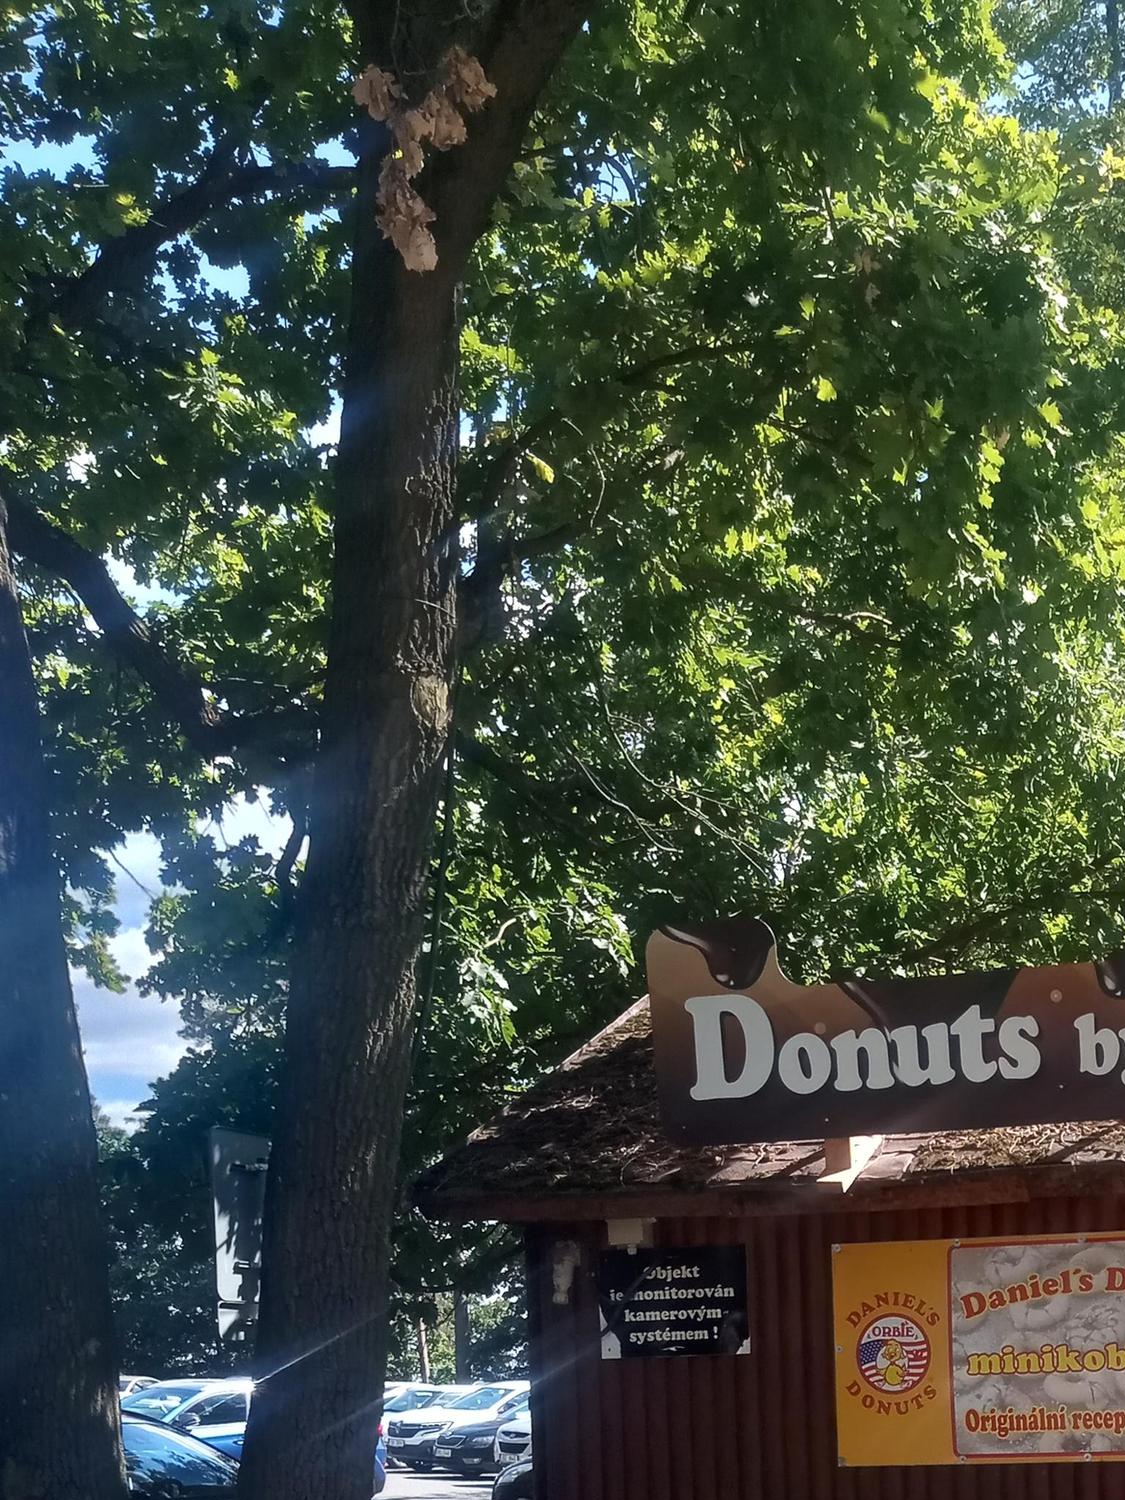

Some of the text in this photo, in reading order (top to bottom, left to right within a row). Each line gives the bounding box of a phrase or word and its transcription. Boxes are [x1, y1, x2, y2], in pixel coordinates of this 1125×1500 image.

[685, 993, 1041, 1102] Donuts
[624, 1305, 722, 1322] kamerovým
[629, 1327, 709, 1344] systémem
[846, 1380, 937, 1416] DONUTS
[965, 1405, 1067, 1437] Originální
